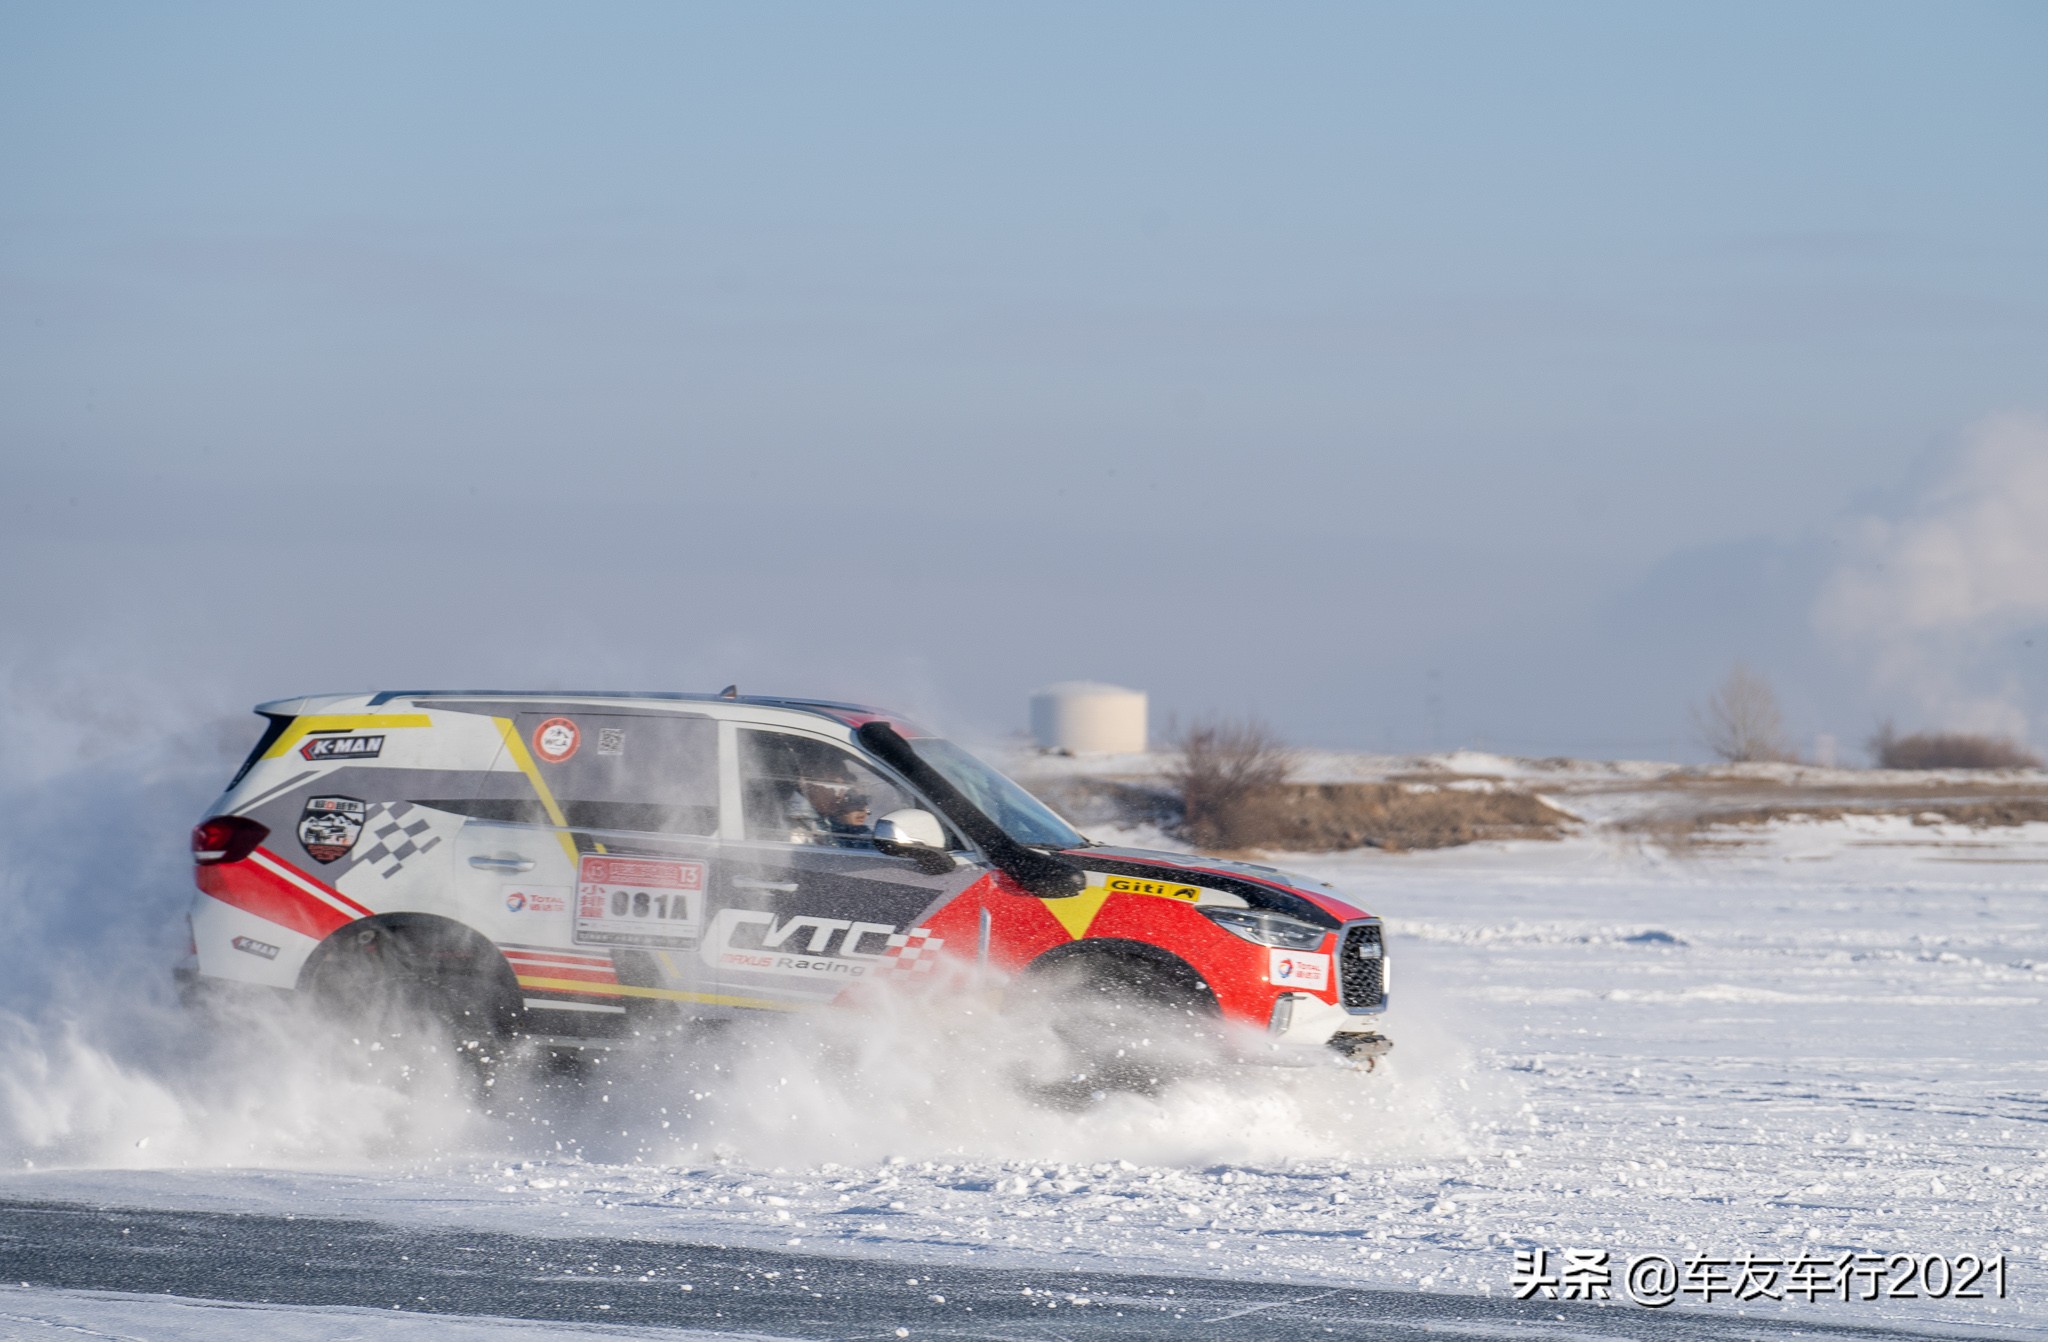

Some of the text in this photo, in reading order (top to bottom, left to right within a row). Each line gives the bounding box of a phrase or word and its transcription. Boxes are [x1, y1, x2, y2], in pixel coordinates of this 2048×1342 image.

[314, 737, 382, 754] K-MAN
[1110, 879, 1164, 895] Giti
[776, 957, 866, 977] Racing
